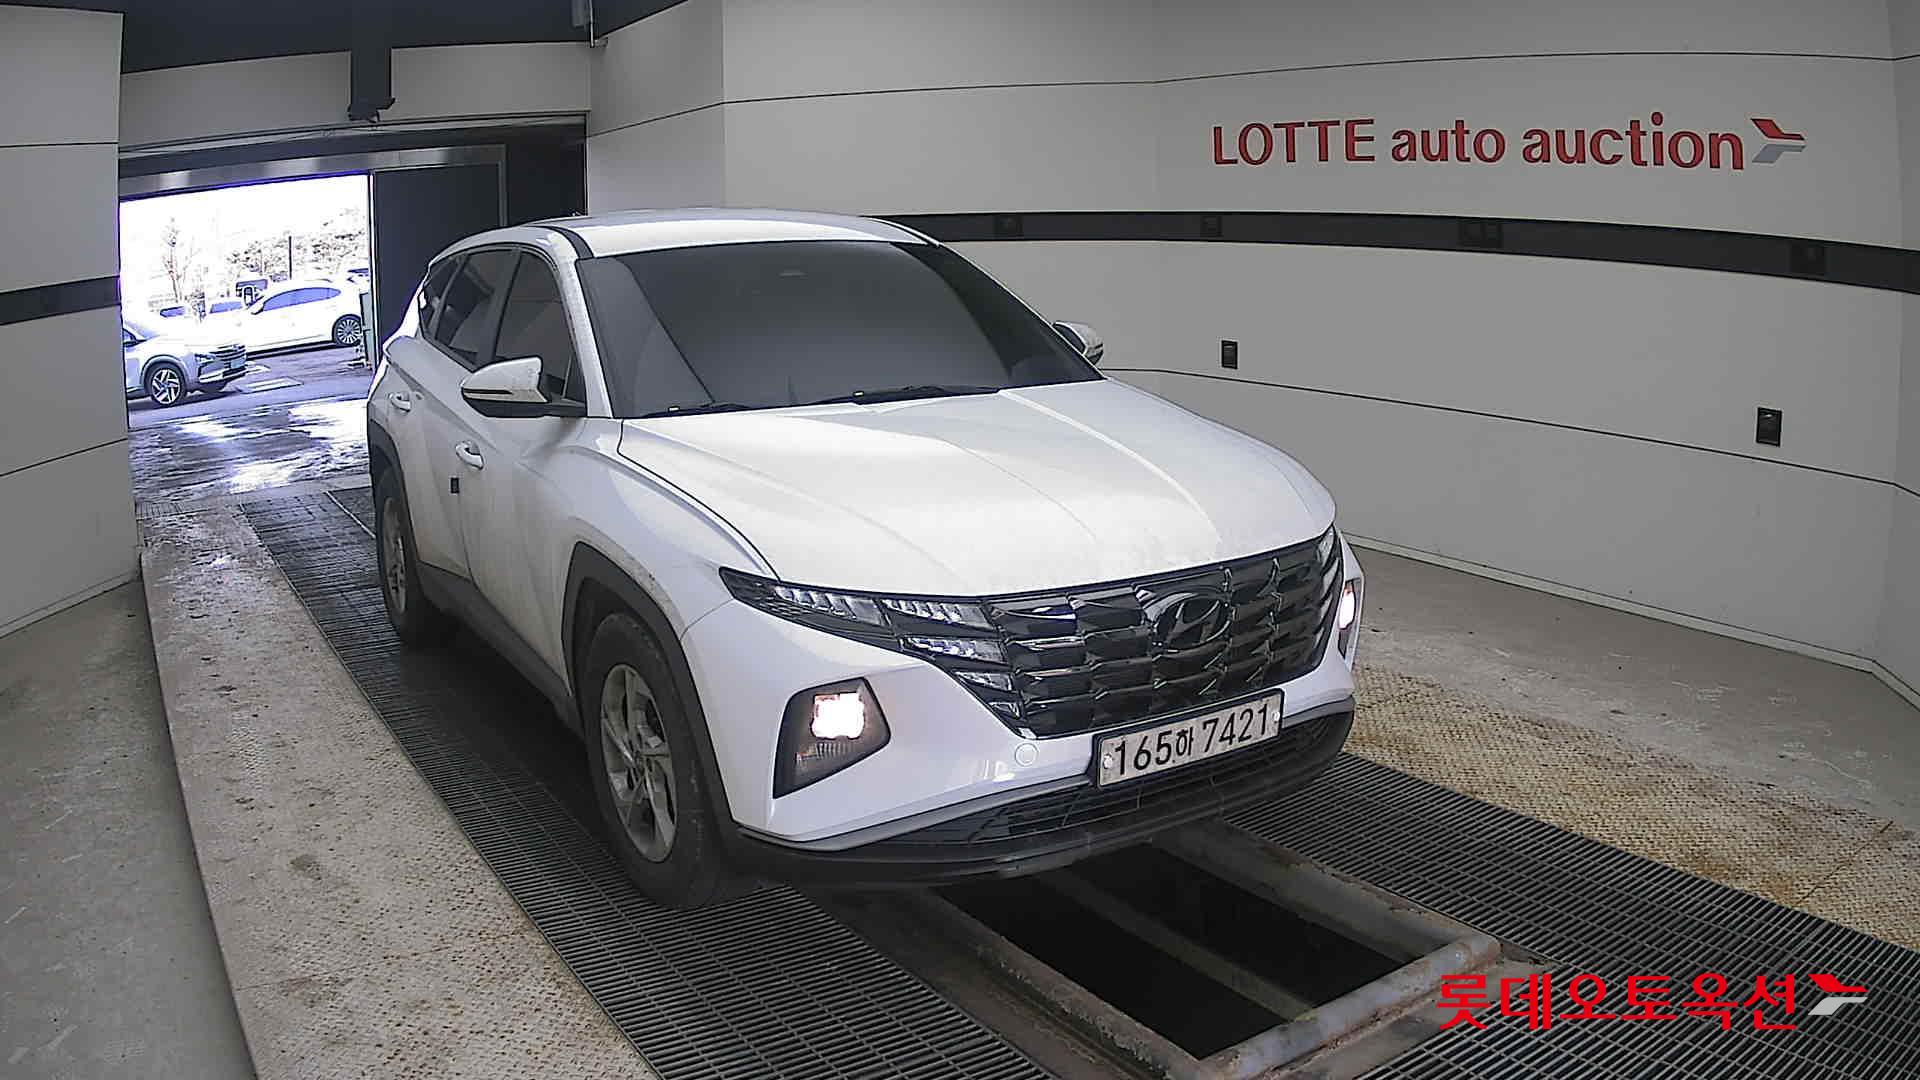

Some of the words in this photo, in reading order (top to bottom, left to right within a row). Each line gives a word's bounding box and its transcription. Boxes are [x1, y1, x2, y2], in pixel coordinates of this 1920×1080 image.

[1212, 118, 1376, 166] LOTTE
[1392, 119, 1506, 163] auto
[1521, 112, 1745, 171] auction
[1115, 727, 1194, 776] 165하
[1203, 703, 1268, 753] 7421
